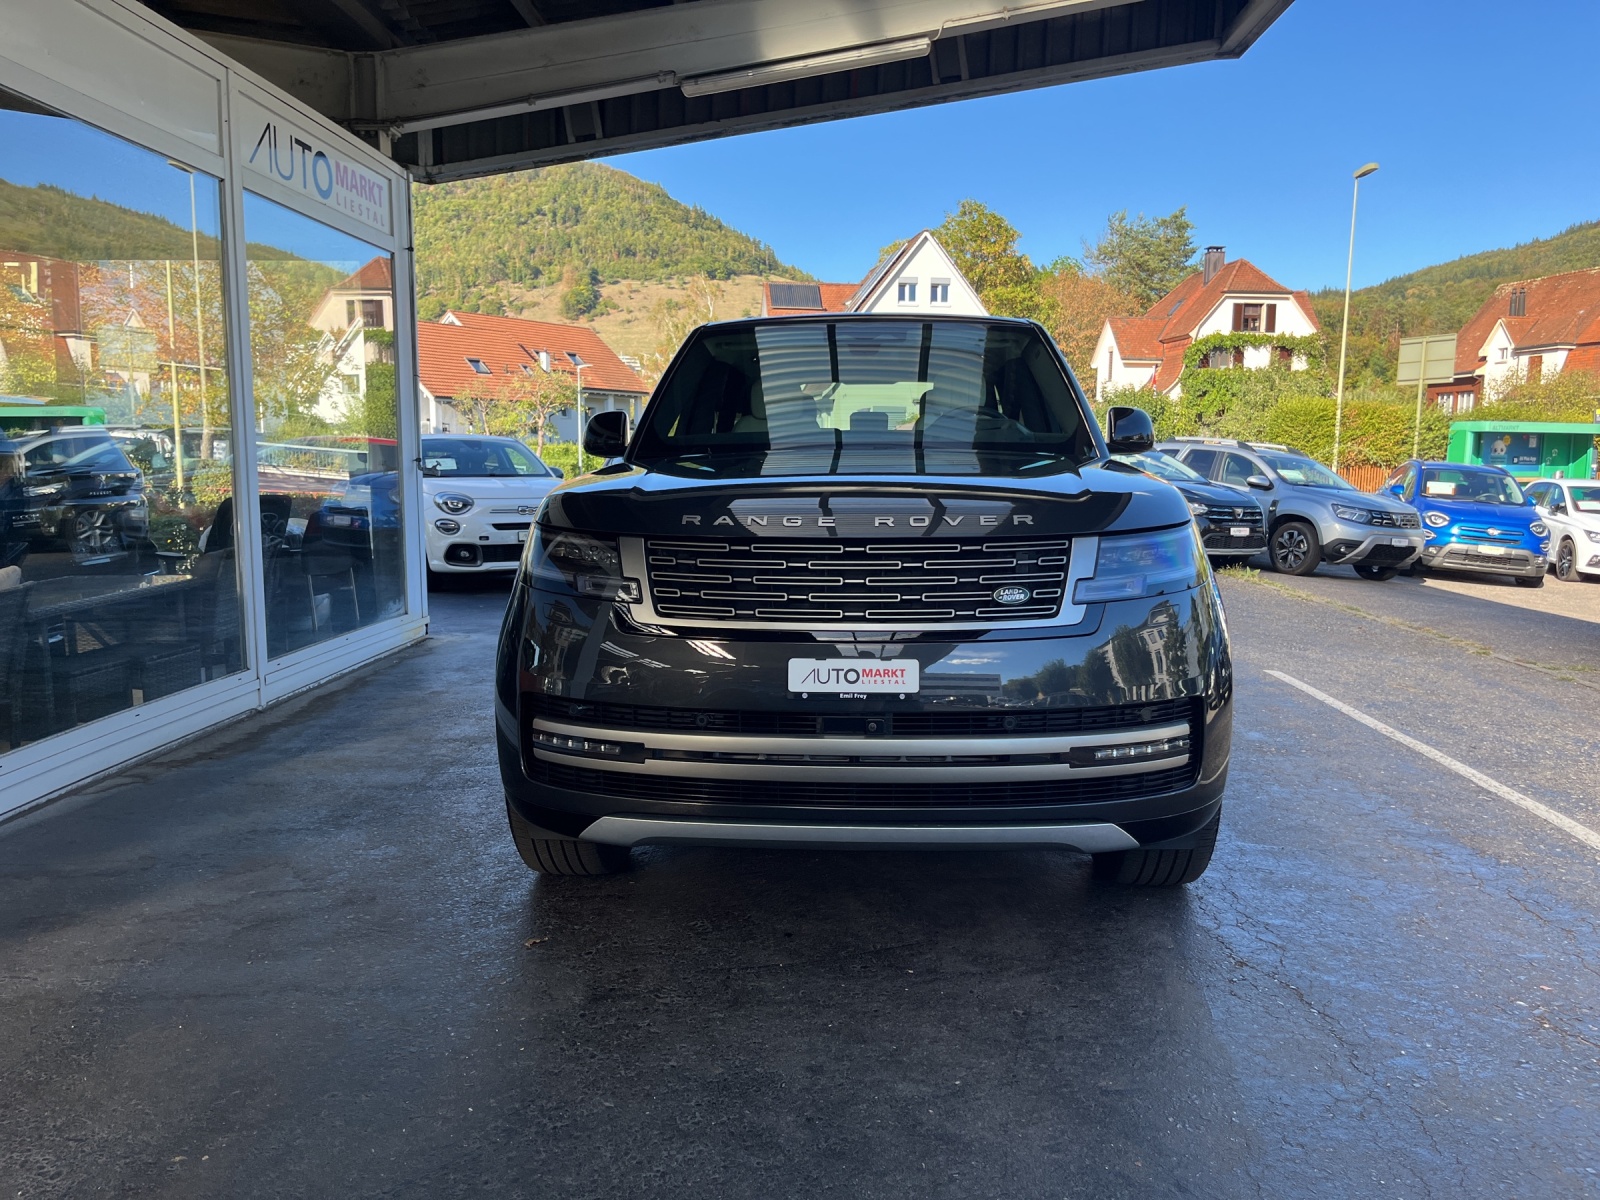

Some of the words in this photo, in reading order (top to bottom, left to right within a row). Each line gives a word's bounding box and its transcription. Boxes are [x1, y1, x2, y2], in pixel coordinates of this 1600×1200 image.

[334, 160, 384, 208] MARKT
[336, 192, 385, 227] LIESTAL
[681, 515, 836, 527] RANGE
[874, 514, 1034, 527] ROVER
[862, 668, 906, 678] MARKT
